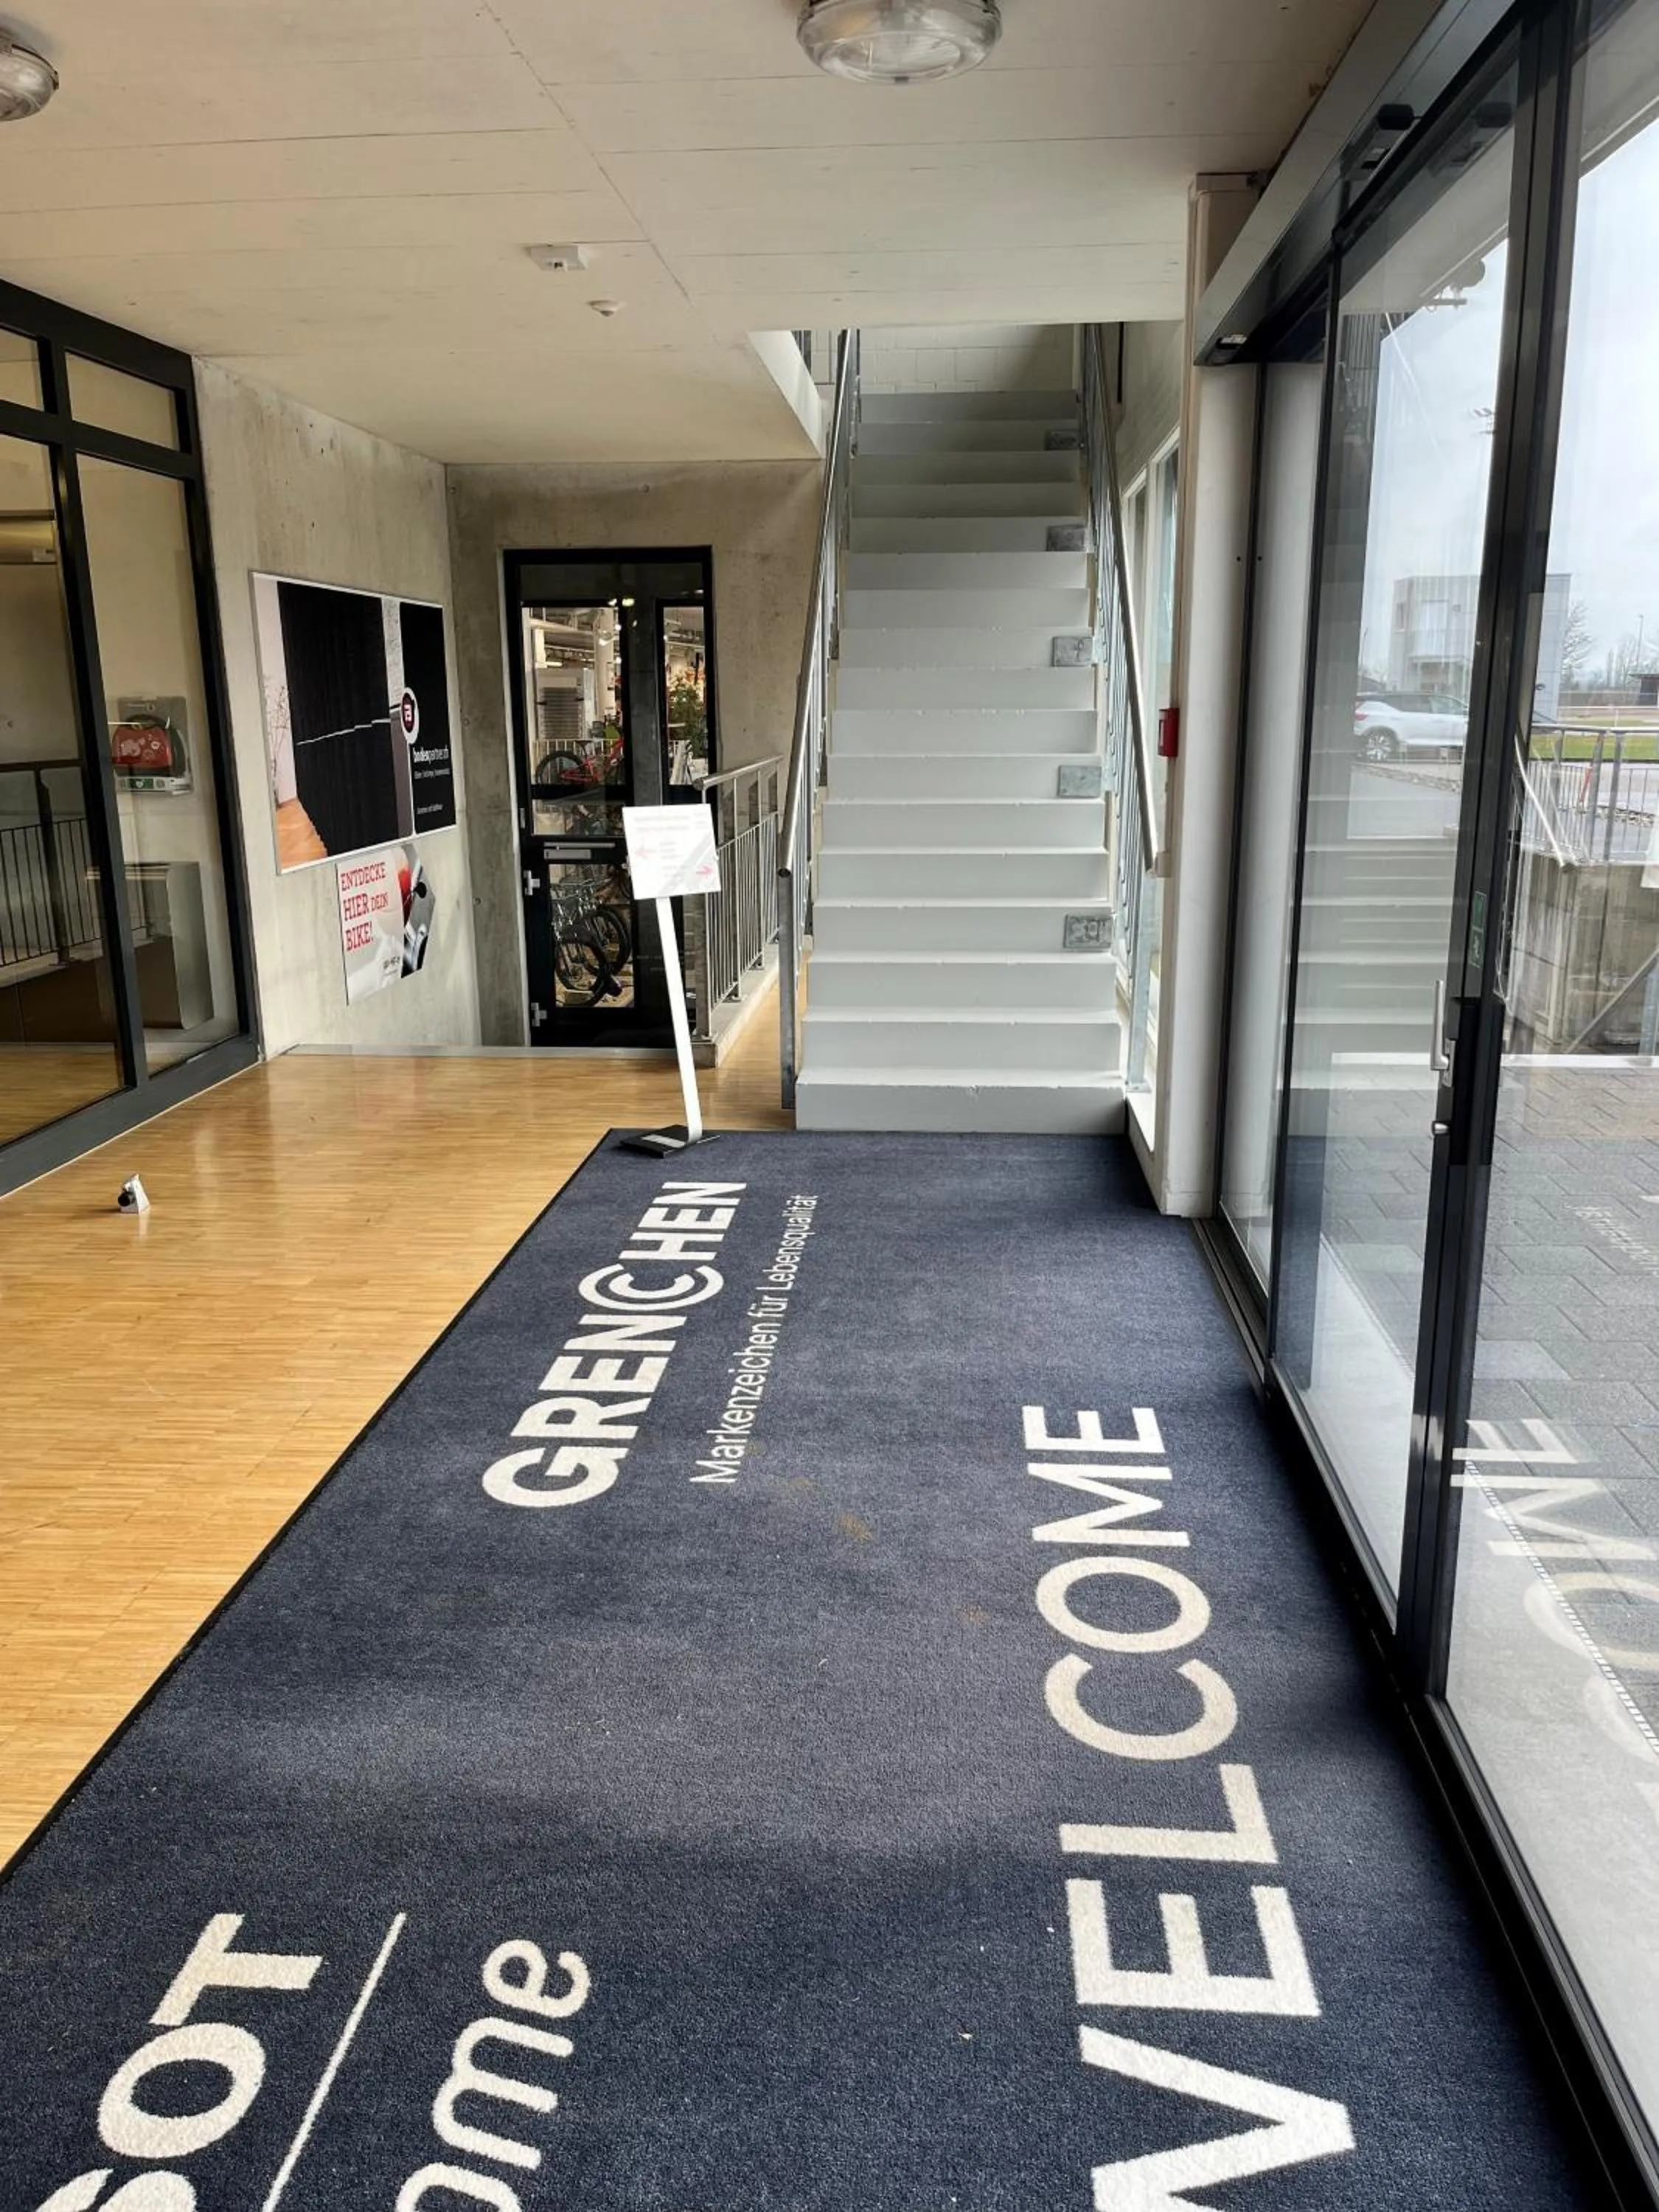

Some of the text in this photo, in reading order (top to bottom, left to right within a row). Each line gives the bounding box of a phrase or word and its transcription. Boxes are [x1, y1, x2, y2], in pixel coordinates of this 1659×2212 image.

[341, 862, 386, 891] ENTDECKE
[343, 892, 388, 921] HIER DEIN
[345, 921, 374, 951] BIKE!
[482, 1182, 747, 1507] GRENCHEN
[690, 1194, 819, 1484] Markenzeichen für Lebensqualität
[1022, 1405, 1356, 2212] WELCOME
